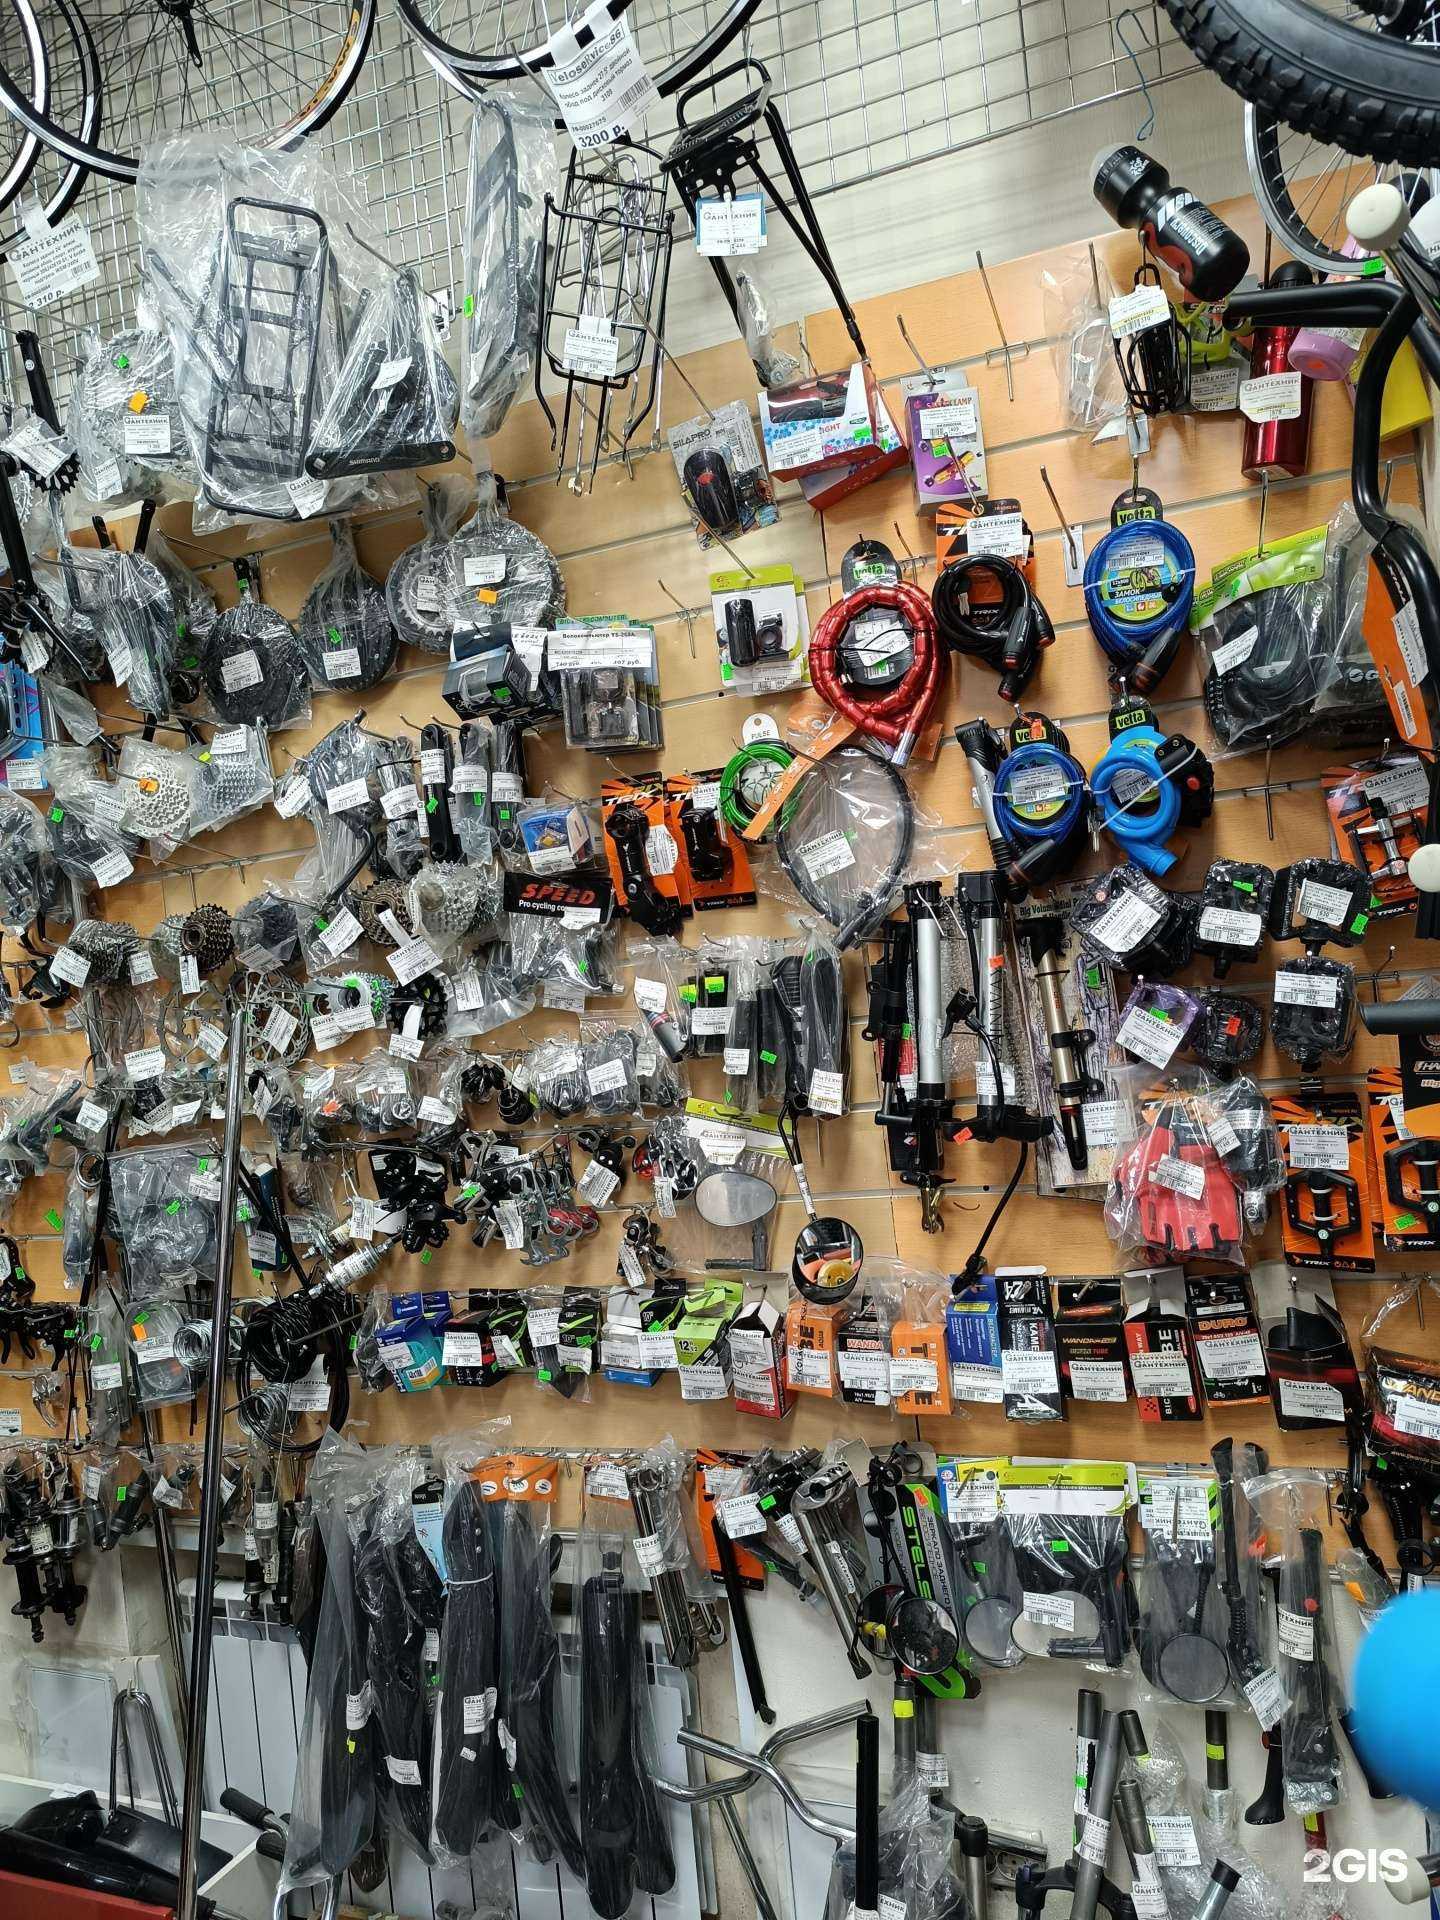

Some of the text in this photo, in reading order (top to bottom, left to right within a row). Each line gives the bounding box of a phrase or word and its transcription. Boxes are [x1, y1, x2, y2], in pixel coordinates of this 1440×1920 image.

[579, 130, 609, 148] 3200
[9, 223, 82, 261] САНТЕХНИК
[36, 292, 54, 306] 310
[1193, 372, 1237, 384] АНТЕХНИК
[1245, 377, 1300, 391] САНТЕХНИК
[673, 428, 711, 449] SILAPRO
[970, 518, 1021, 528] САНТЕХНИК
[1115, 589, 1140, 598] ЗАМОК
[1117, 713, 1144, 727] vetta
[1365, 767, 1423, 788] САНТЕХНИК
[606, 789, 657, 806] TRIX
[520, 883, 596, 905] SPEED
[519, 899, 530, 908] Pro
[531, 901, 556, 911] cycling
[1020, 905, 1032, 916] Big
[1094, 894, 1134, 935] САНТЕХНИК
[1134, 1009, 1181, 1040] САНТЕХНИК
[1289, 1126, 1347, 1136] САНТЕХНИК
[1198, 1317, 1248, 1330] DURO
[847, 1339, 883, 1350] WANDA
[1205, 1335, 1258, 1348] САНТЕХНИК
[1005, 1352, 1054, 1362] САНТЕХНИК
[954, 1363, 1001, 1374] САНТЕХНИК
[902, 1506, 933, 1600] STELS
[927, 1516, 950, 1604] ЗЕРКАЛО ЗАДНЕГО
